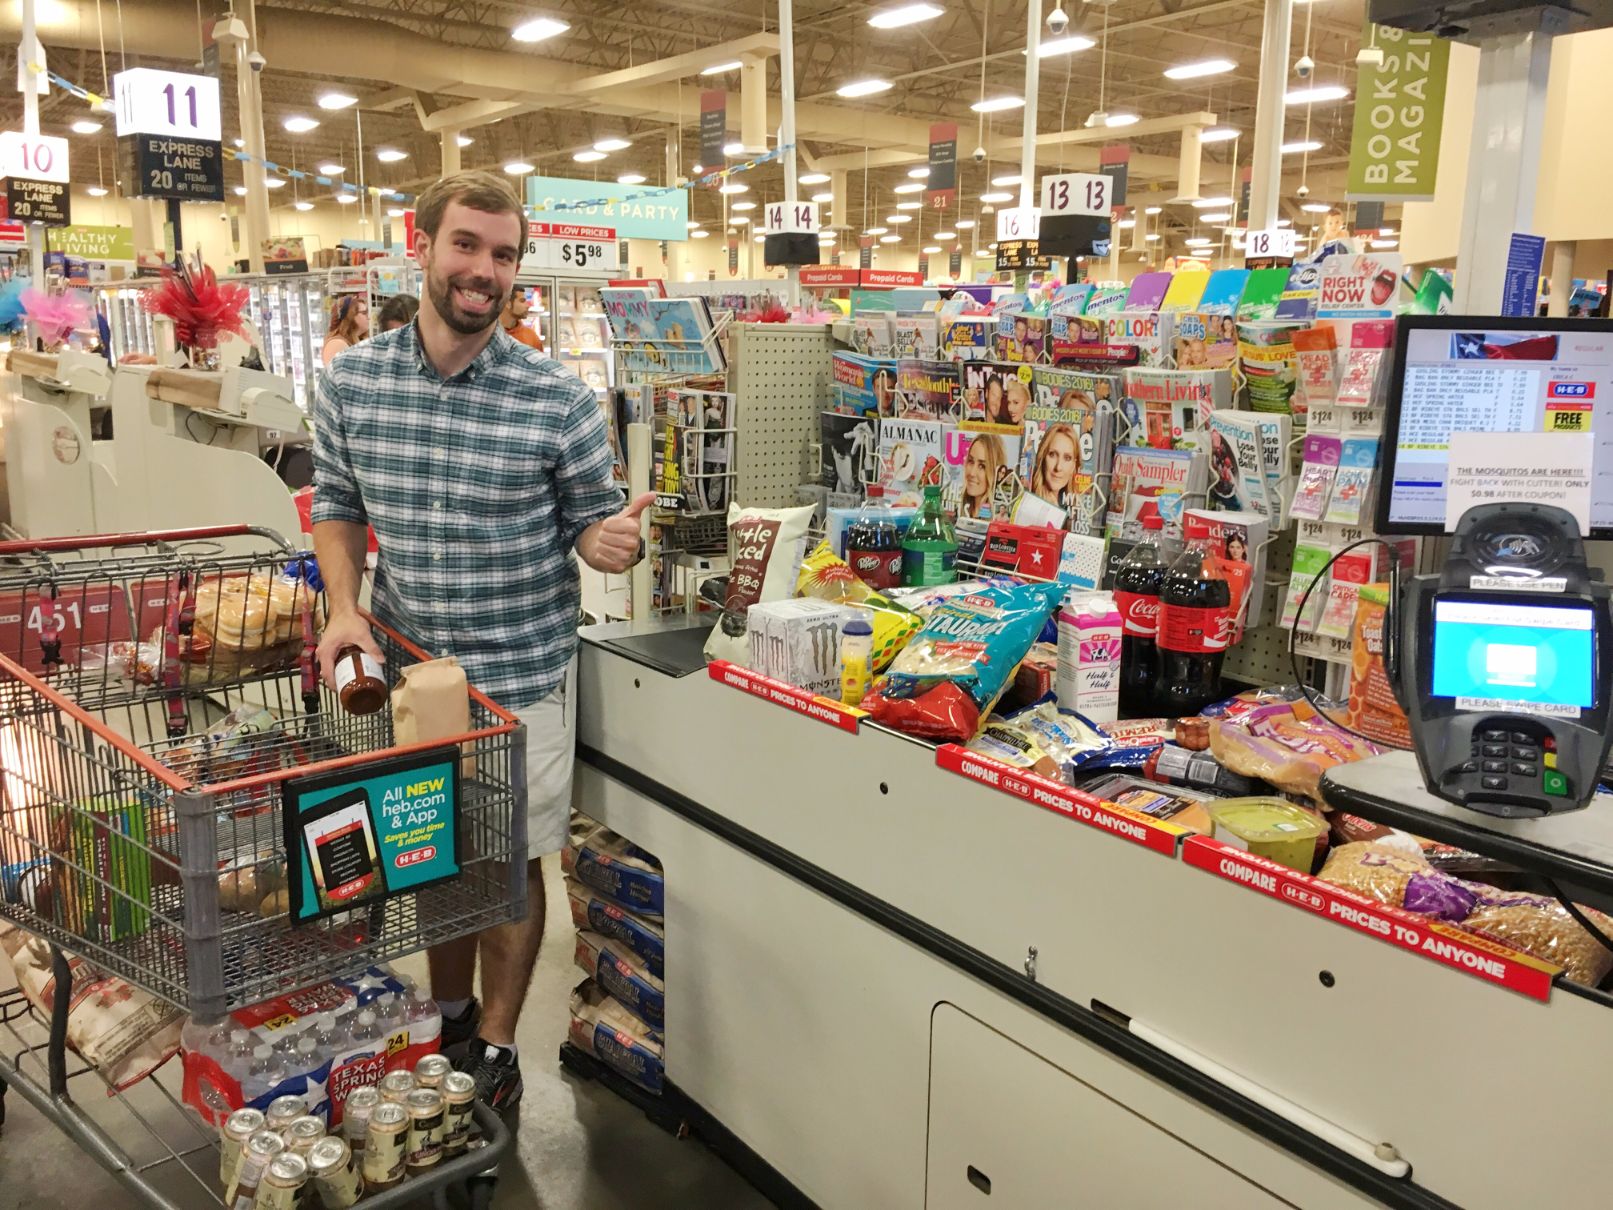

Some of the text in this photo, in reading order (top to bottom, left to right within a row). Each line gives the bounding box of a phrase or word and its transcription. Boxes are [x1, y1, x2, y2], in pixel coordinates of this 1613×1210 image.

[162, 83, 198, 128] 11
[1394, 38, 1432, 183] MAGAZI
[1364, 54, 1400, 183] BOOKS
[149, 140, 215, 158] EXPRESS
[21, 143, 53, 173] 10
[164, 155, 201, 170] LANE
[151, 169, 207, 189] 20 ITEMS
[13, 181, 63, 194] EXPRESS
[1050, 181, 1069, 210] 13
[1086, 181, 1104, 210] 13
[24, 192, 53, 203] LANE
[933, 195, 946, 208] 21
[14, 202, 31, 216] 20
[603, 203, 615, 216] &
[621, 203, 680, 221] PARTY
[769, 206, 782, 230] 14
[794, 206, 812, 230] 14
[1005, 214, 1019, 236] 16
[560, 226, 609, 238] LOW PRICES
[1254, 233, 1269, 253] 18
[807, 273, 826, 282] Prepaid
[870, 273, 915, 283] Prepaid Cards
[1323, 277, 1365, 289] RIGHT
[1088, 293, 1124, 311] mentos
[1322, 289, 1366, 303] NOW
[1108, 319, 1158, 337] COLOR!
[1268, 351, 1297, 361] LOVE
[1301, 354, 1330, 362] HEAD
[1032, 408, 1081, 422] BODIES 2016!
[1554, 412, 1582, 424] FREE
[881, 425, 938, 443] ALMANAC
[1210, 415, 1254, 442] Prevention
[1237, 439, 1256, 452] Lose
[1239, 450, 1256, 461] Your
[1114, 453, 1187, 484] Quilt Sampler
[1238, 457, 1258, 473] Belly
[1475, 468, 1529, 476] MOSQUITOS
[1565, 480, 1590, 488] ONLY
[654, 496, 678, 508] OBE
[1071, 520, 1090, 534] LOSS
[737, 574, 760, 590] BBQ
[1331, 591, 1354, 600] CARE
[1086, 672, 1108, 680] Half
[800, 679, 841, 692] MONSTE
[1090, 680, 1111, 689] Half
[724, 672, 750, 689] COMPARE
[770, 689, 795, 706] PRICES
[796, 699, 807, 711] TO
[807, 703, 841, 724] ANYONE
[1461, 698, 1502, 707] PLEASE
[1544, 705, 1577, 714] CARD
[383, 777, 445, 804] All NEW
[382, 793, 446, 817] heb.com
[961, 760, 999, 785] COMPARE
[1033, 788, 1073, 813] PRICES
[1075, 803, 1092, 819] TO
[1093, 812, 1147, 842] ANYONE
[391, 809, 438, 829] & App
[384, 822, 446, 844] Saves you time
[397, 832, 433, 847] & money
[1220, 859, 1277, 892] COMPARE
[1330, 900, 1391, 938] PRICES
[1394, 925, 1419, 945] TO
[1422, 938, 1506, 979] ANYONE
[388, 1034, 404, 1050] 24
[334, 1056, 386, 1082] TEXAS
[334, 1069, 386, 1094] SPRING
